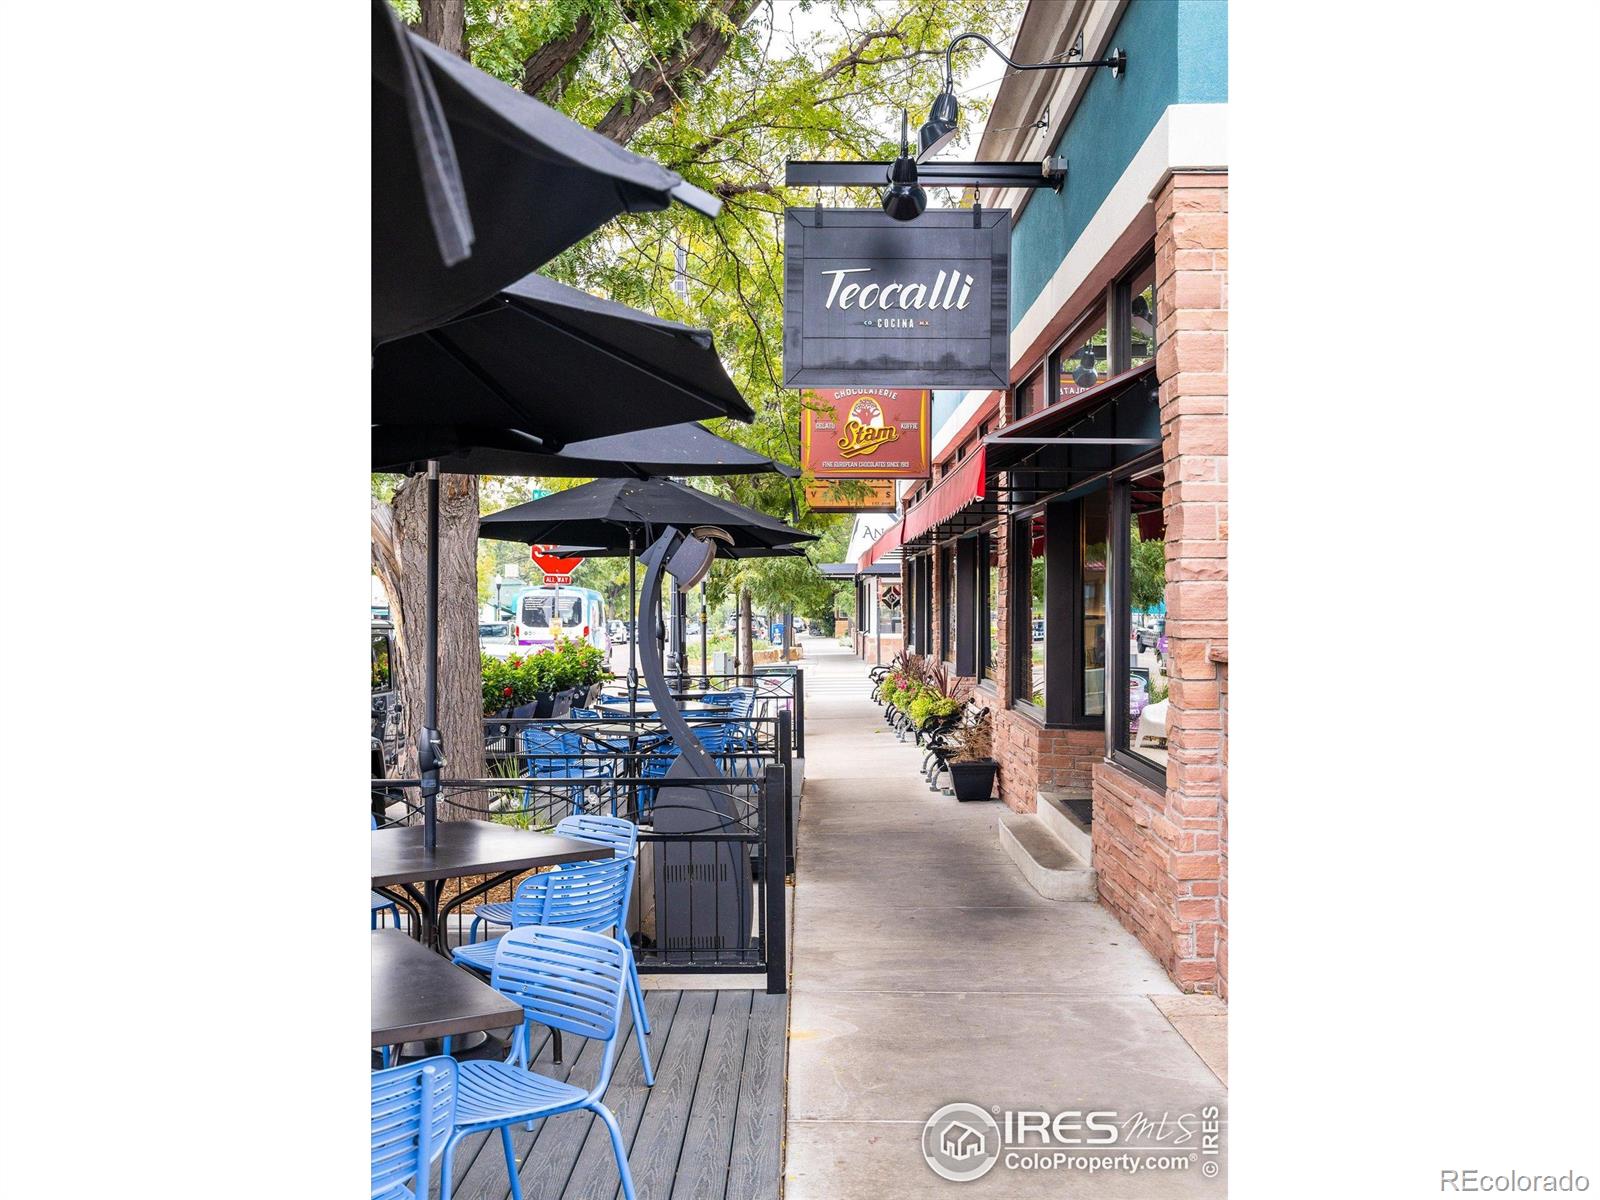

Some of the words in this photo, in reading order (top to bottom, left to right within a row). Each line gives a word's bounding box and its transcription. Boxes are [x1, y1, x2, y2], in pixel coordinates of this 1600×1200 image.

[821, 267, 974, 311] Teocalli
[877, 318, 914, 329] COCINA
[834, 388, 898, 400] CHOCOLATERIE
[838, 420, 898, 448] Stam
